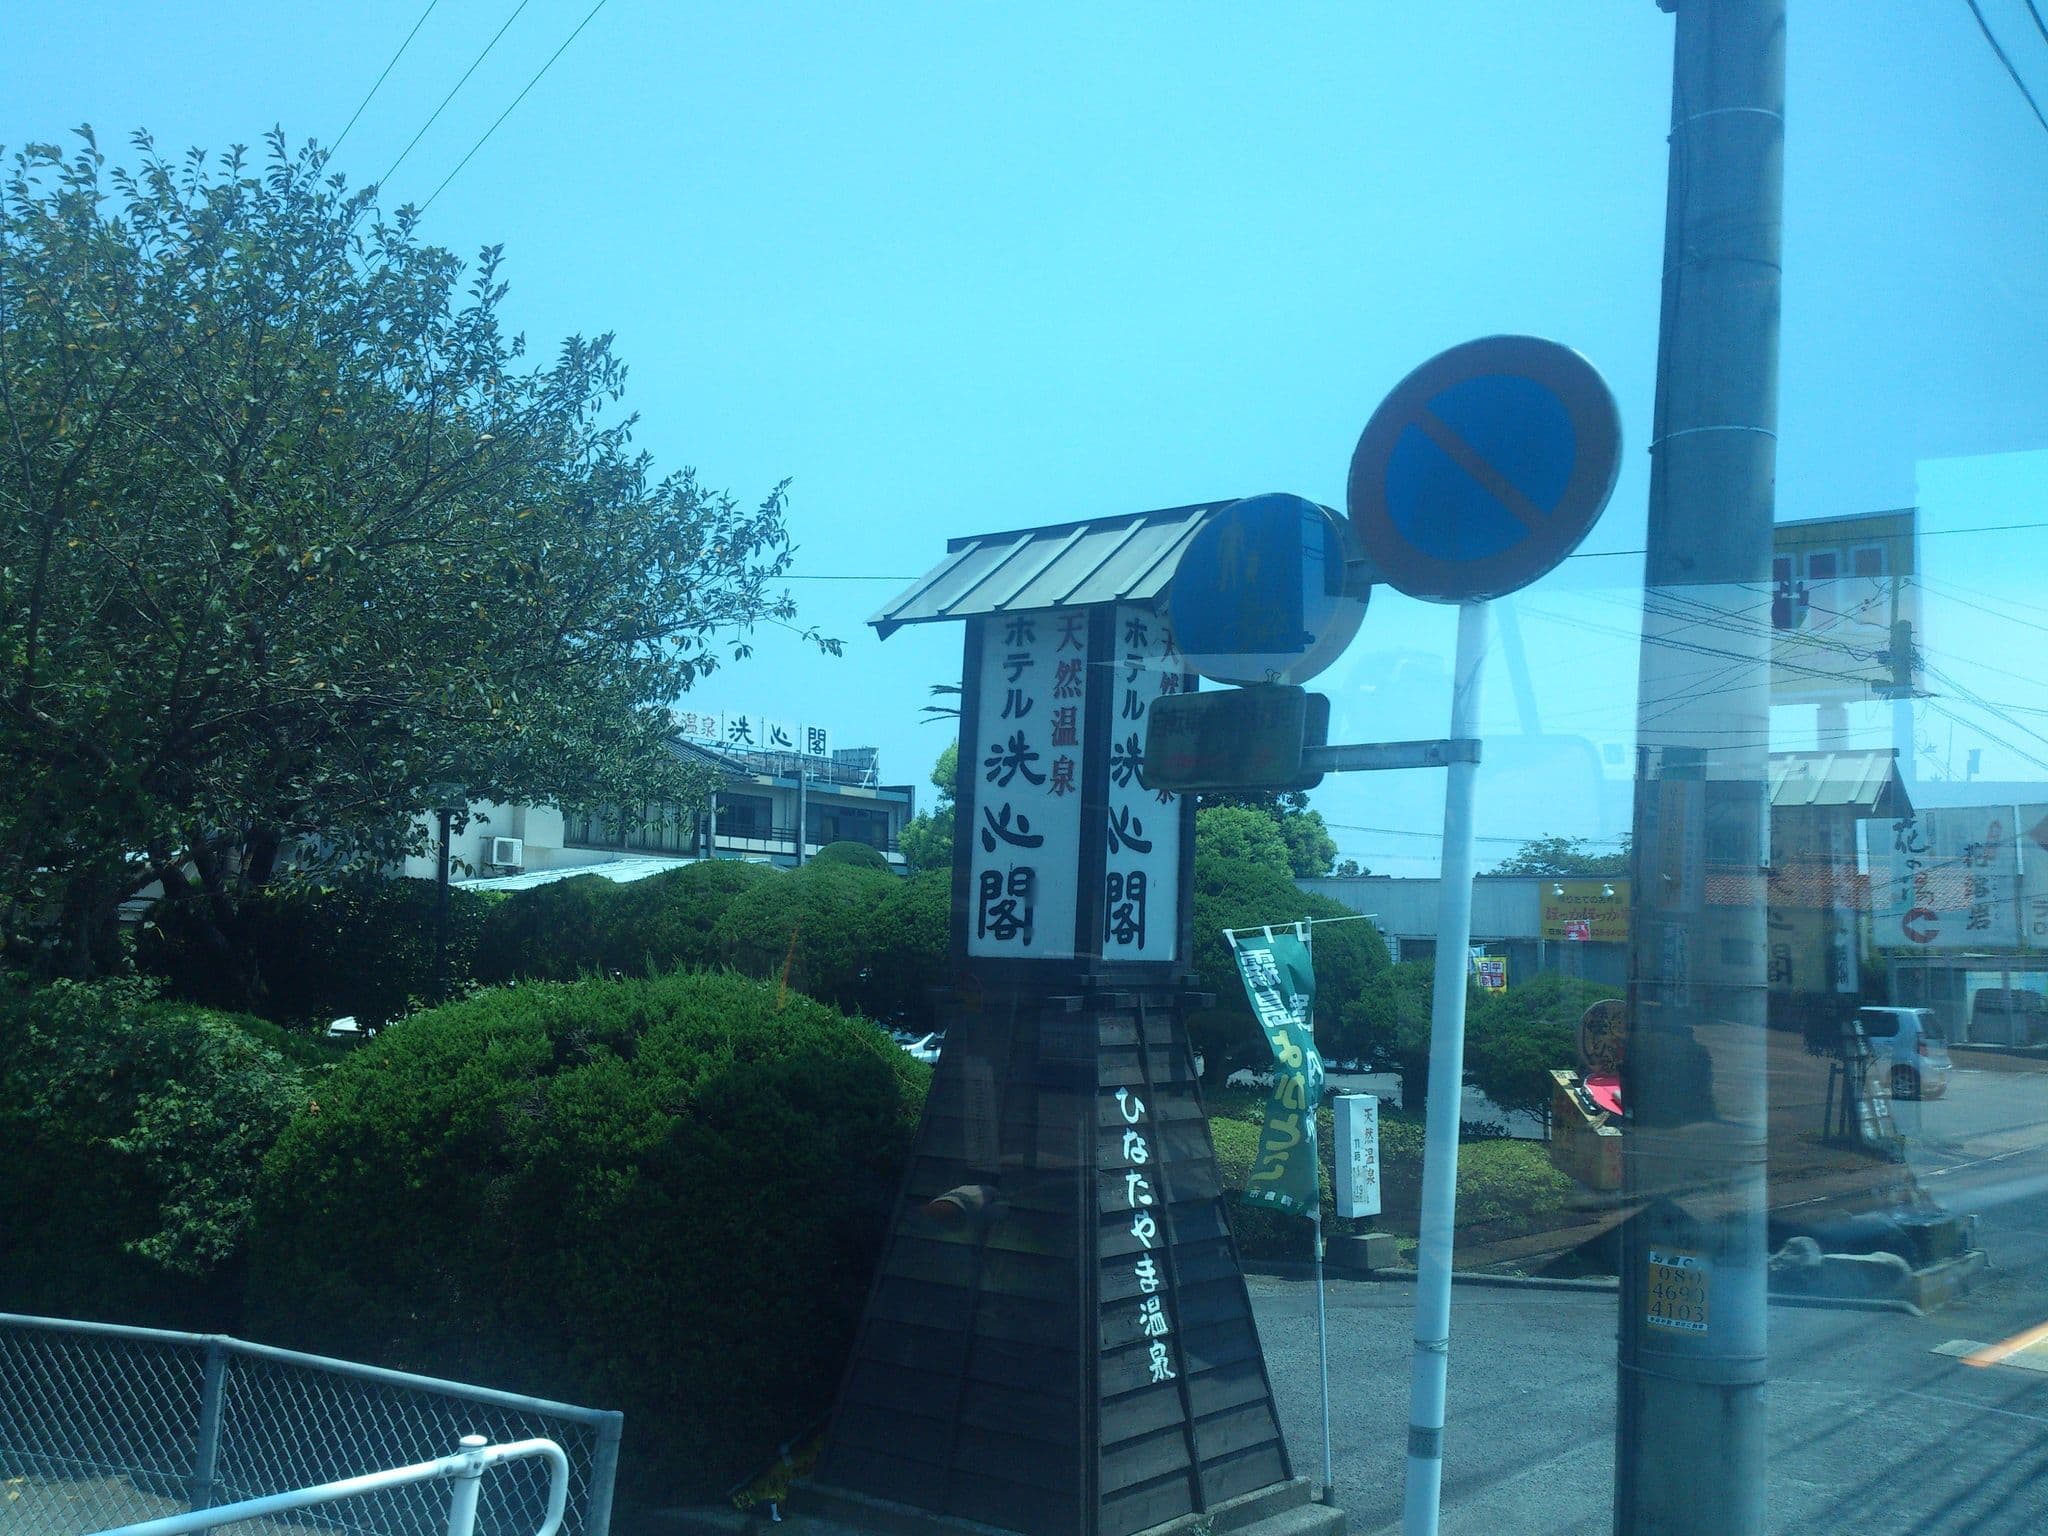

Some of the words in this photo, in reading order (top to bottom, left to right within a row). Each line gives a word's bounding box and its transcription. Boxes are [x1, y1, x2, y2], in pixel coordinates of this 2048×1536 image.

[1047, 613, 1084, 797] 天然温泉
[1363, 1106, 1376, 1186] 天然温泉
[1114, 1086, 1176, 1384] ひなたやま温泉
[1651, 1301, 1704, 1322] 4103
